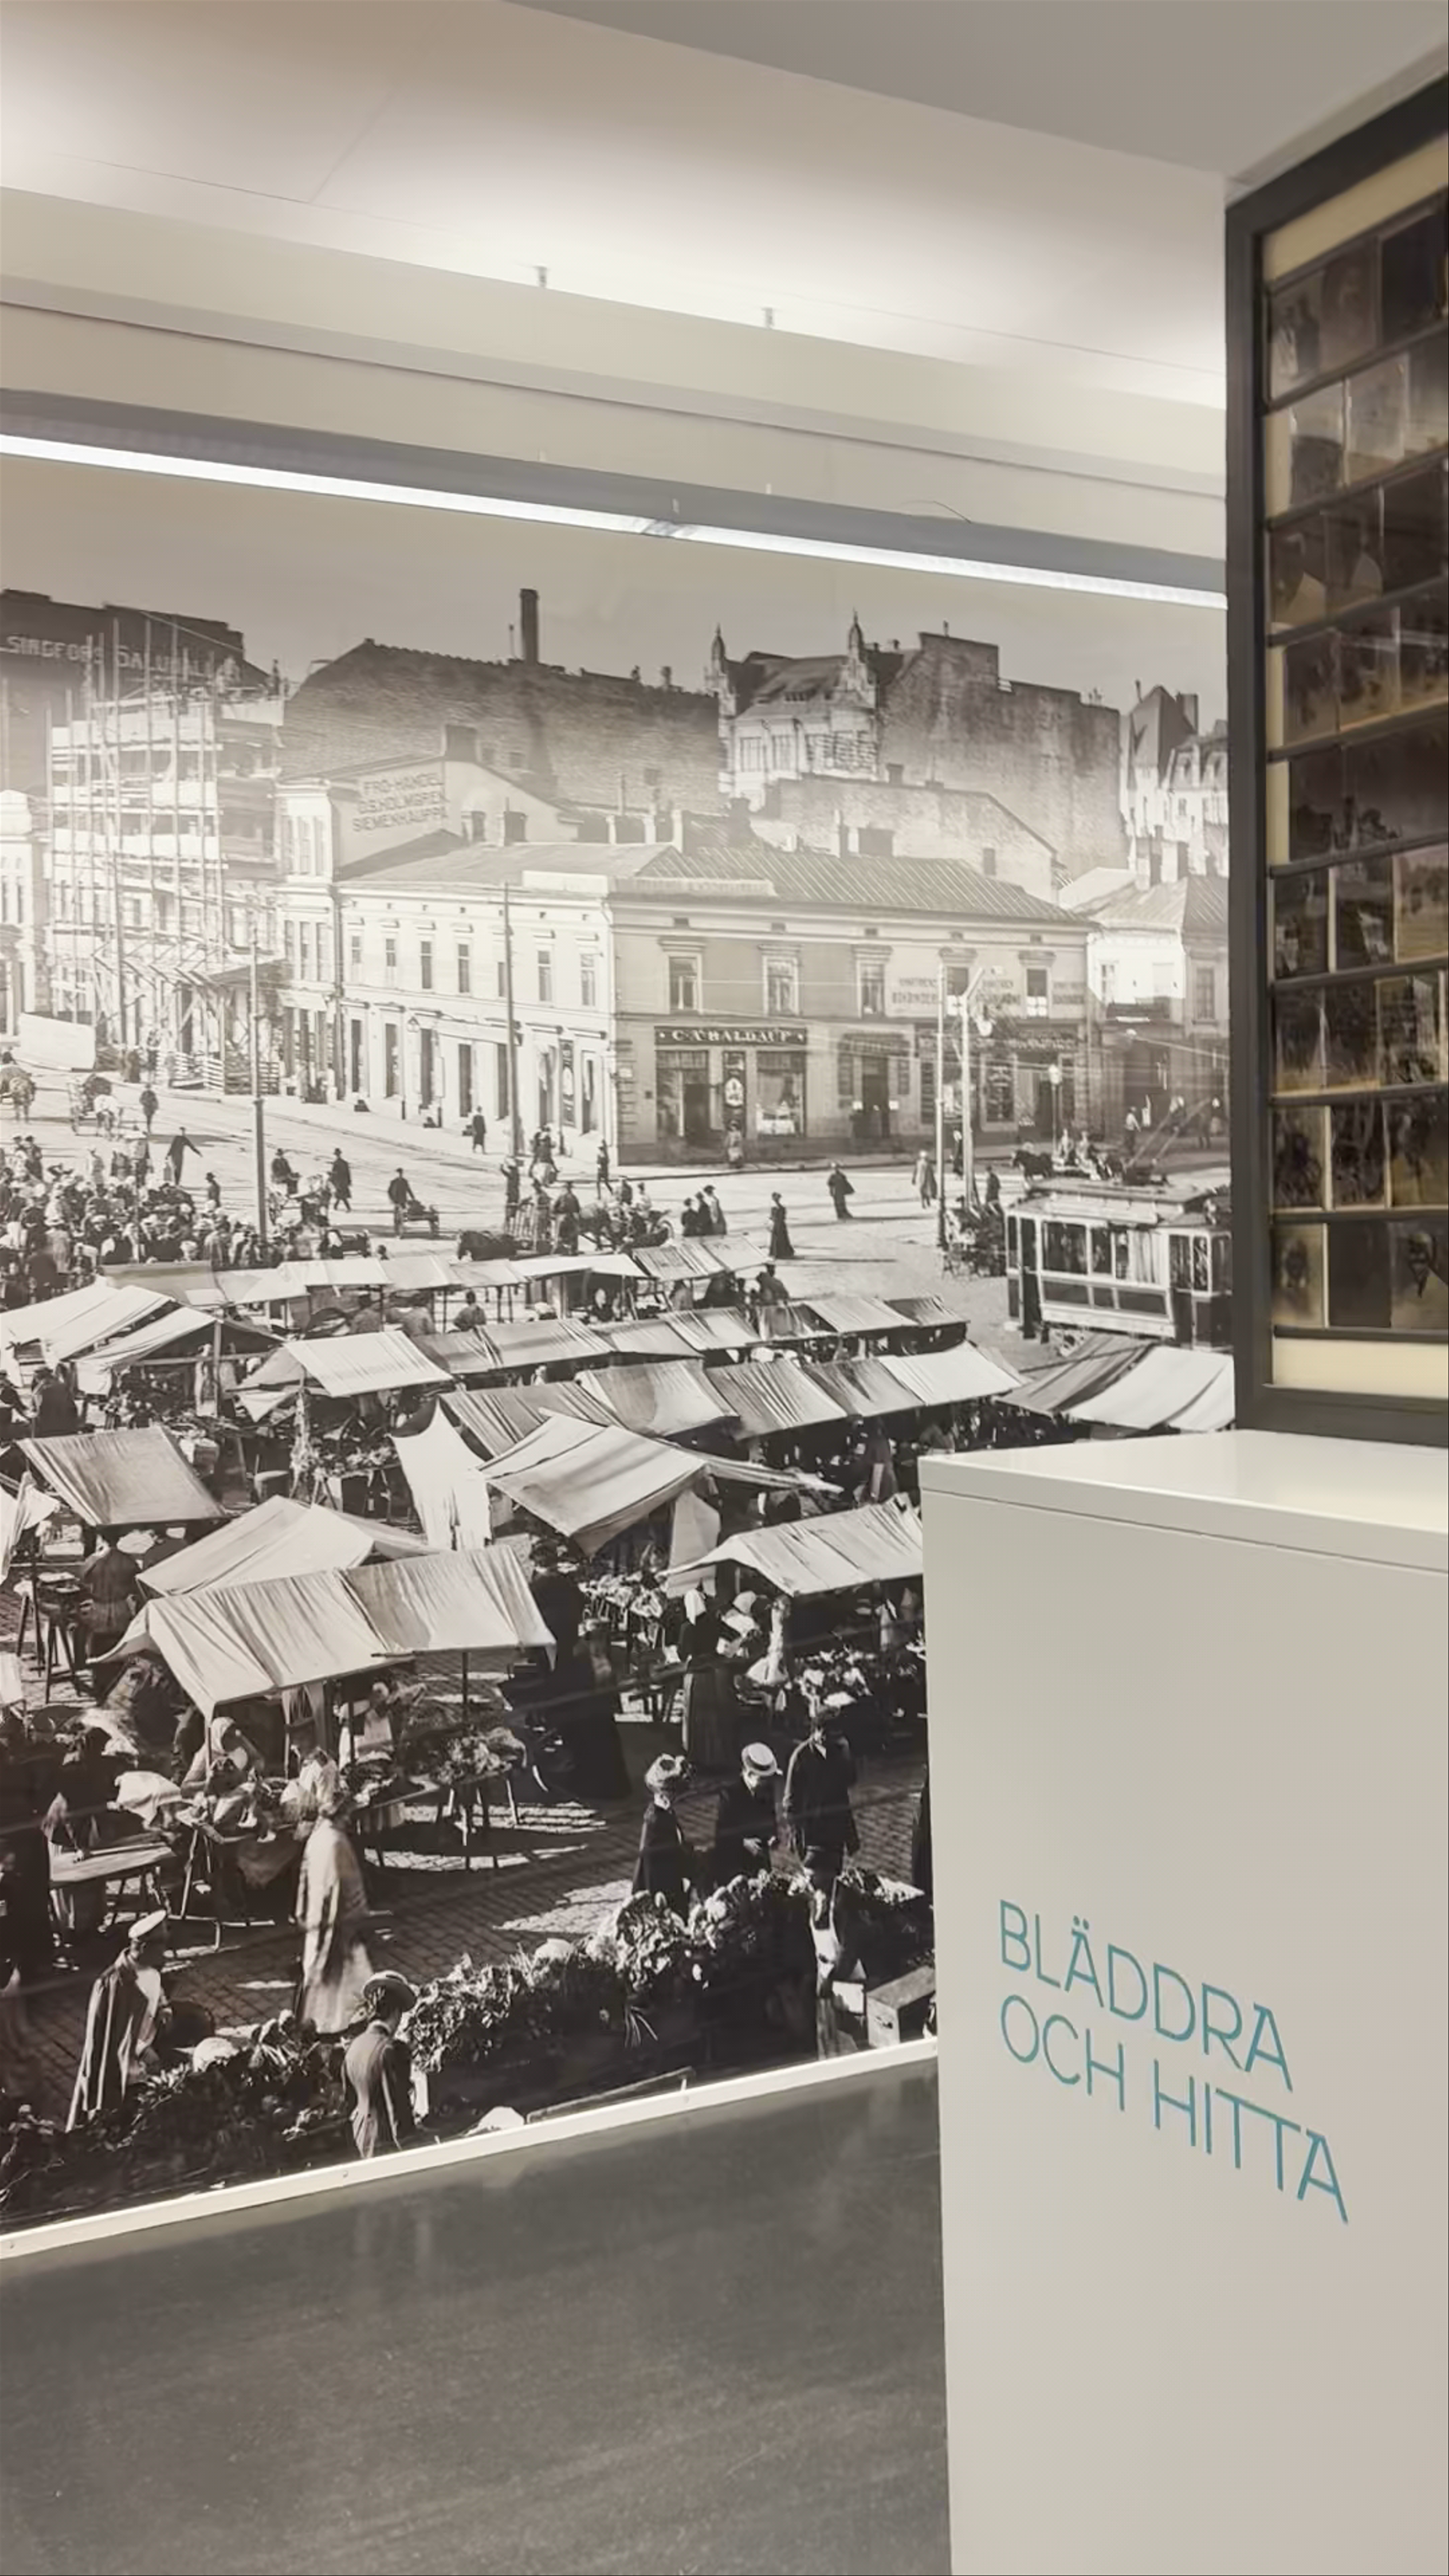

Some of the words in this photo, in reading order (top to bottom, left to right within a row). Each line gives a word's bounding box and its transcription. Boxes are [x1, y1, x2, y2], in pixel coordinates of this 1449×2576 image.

[1000, 1899, 1293, 2093] BLÄDDRA
[1000, 1994, 1124, 2111] OCH
[1153, 2059, 1348, 2224] HITTA
